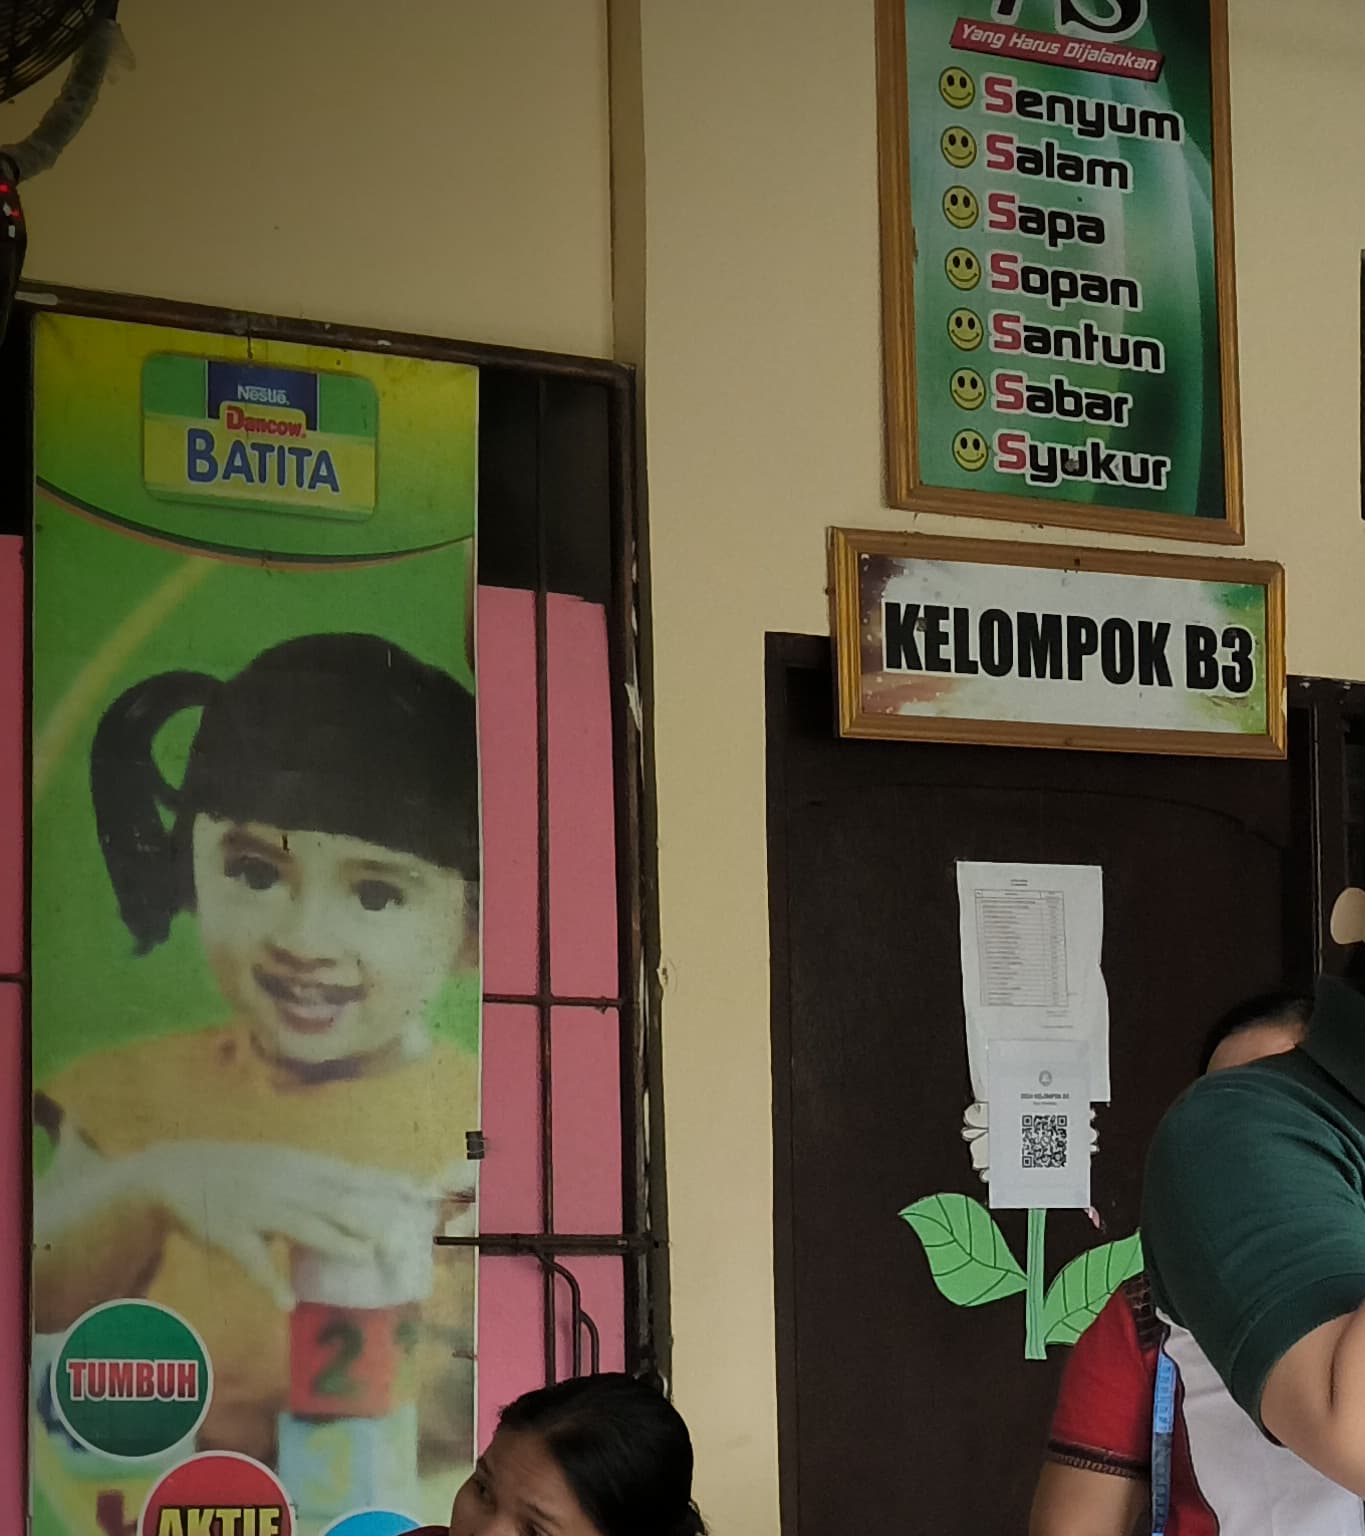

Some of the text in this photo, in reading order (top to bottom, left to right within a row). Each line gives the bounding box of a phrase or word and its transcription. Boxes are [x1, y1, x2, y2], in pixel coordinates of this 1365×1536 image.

[961, 23, 1158, 72] Yang Harus Dijalankan
[984, 75, 1182, 142] Senyum
[985, 133, 1130, 190] Salam
[987, 192, 1106, 248] Sapa
[990, 252, 1139, 309] Sopan
[992, 312, 1162, 371] Santun
[995, 373, 1129, 424] Sabar
[187, 427, 340, 493] BATITA
[997, 432, 1167, 487] Syukur
[884, 601, 1256, 694] KELOMPOK B3
[67, 1361, 197, 1400] TUMBUH
